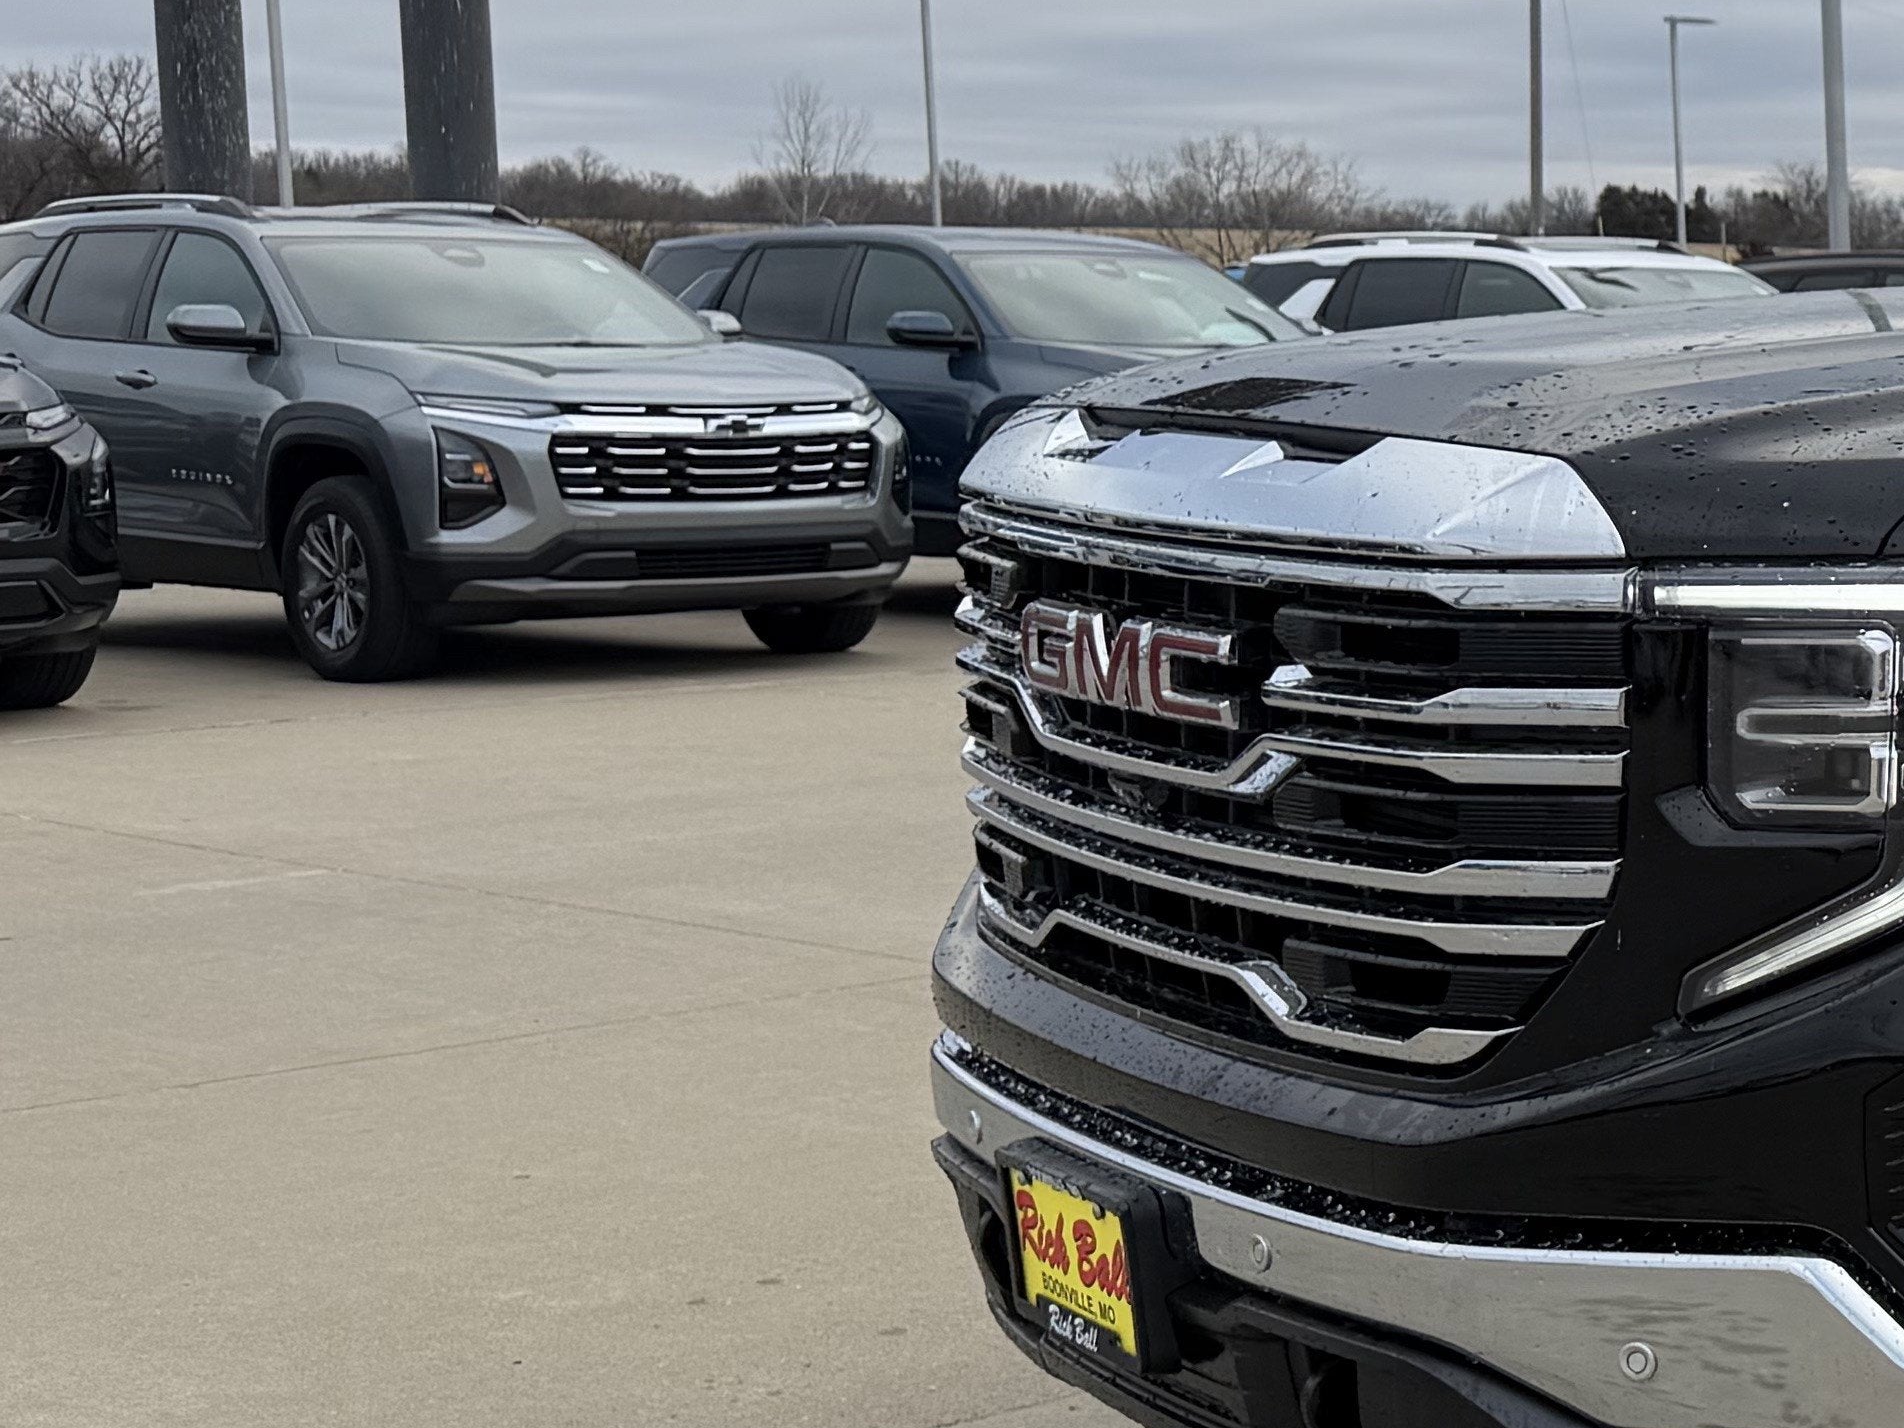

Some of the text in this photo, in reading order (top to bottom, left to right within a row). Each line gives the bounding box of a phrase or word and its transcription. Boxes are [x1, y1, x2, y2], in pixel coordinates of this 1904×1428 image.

[1021, 599, 1239, 730] GMC
[1015, 1189, 1071, 1277] Rick
[1048, 1303, 1099, 1353] Rick Ball
[1098, 1301, 1117, 1325] MO
